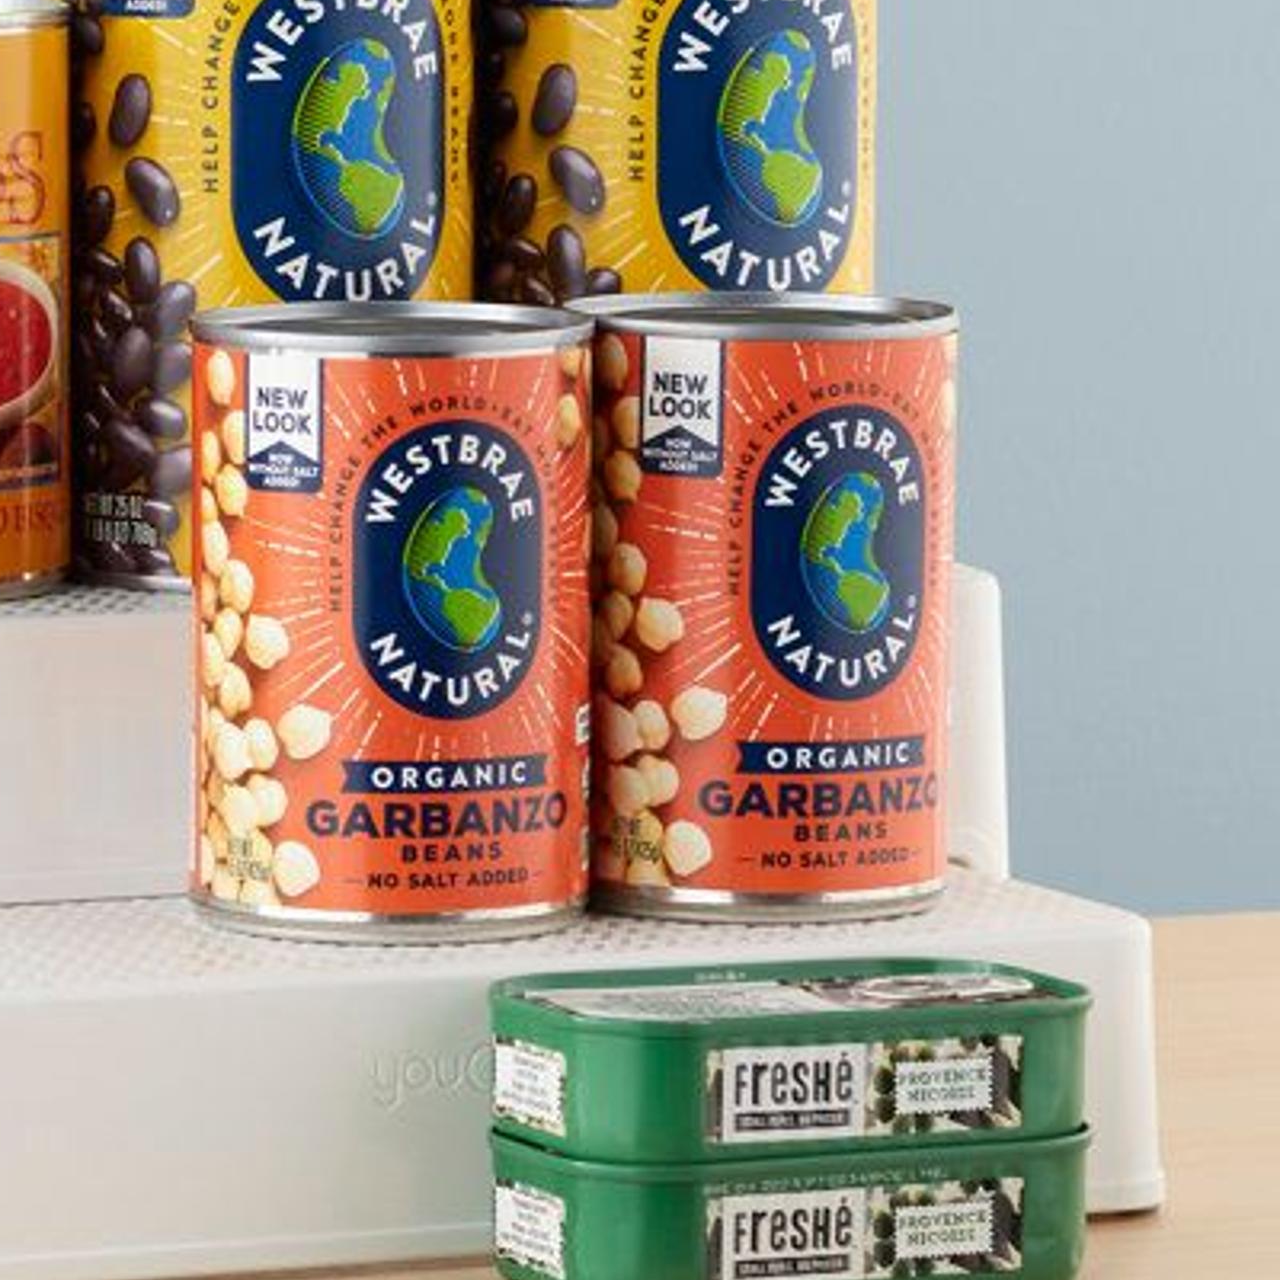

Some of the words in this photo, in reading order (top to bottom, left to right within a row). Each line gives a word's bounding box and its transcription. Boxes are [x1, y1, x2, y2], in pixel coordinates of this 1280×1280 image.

[202, 1, 240, 110] CHANGE
[202, 125, 220, 193] HELP
[627, 114, 646, 183] HELP
[253, 211, 437, 302] NATURAL
[678, 204, 851, 292] NATURAL
[256, 386, 310, 409] NEW
[648, 396, 712, 421] LOOK
[652, 372, 710, 397] NEW
[762, 401, 800, 434] THE
[808, 380, 882, 403] WORLD
[252, 410, 313, 436] LOOK
[364, 417, 402, 451] THE
[408, 397, 488, 418] WORLD
[365, 433, 536, 525] WESTBRAE
[764, 419, 920, 507] WESTBRAE
[370, 630, 526, 707] NATURAL
[768, 612, 913, 687] NATURAL
[370, 761, 527, 790] ORGANIC
[765, 741, 911, 770] ORGANIC
[305, 790, 569, 840] GARBANZO
[793, 821, 889, 844] BEANS
[400, 840, 504, 865] BEANS
[760, 850, 792, 868] NO
[799, 848, 848, 868] SALT
[366, 873, 400, 891] NO
[406, 872, 459, 890] SALT
[465, 869, 529, 887] ADDED
